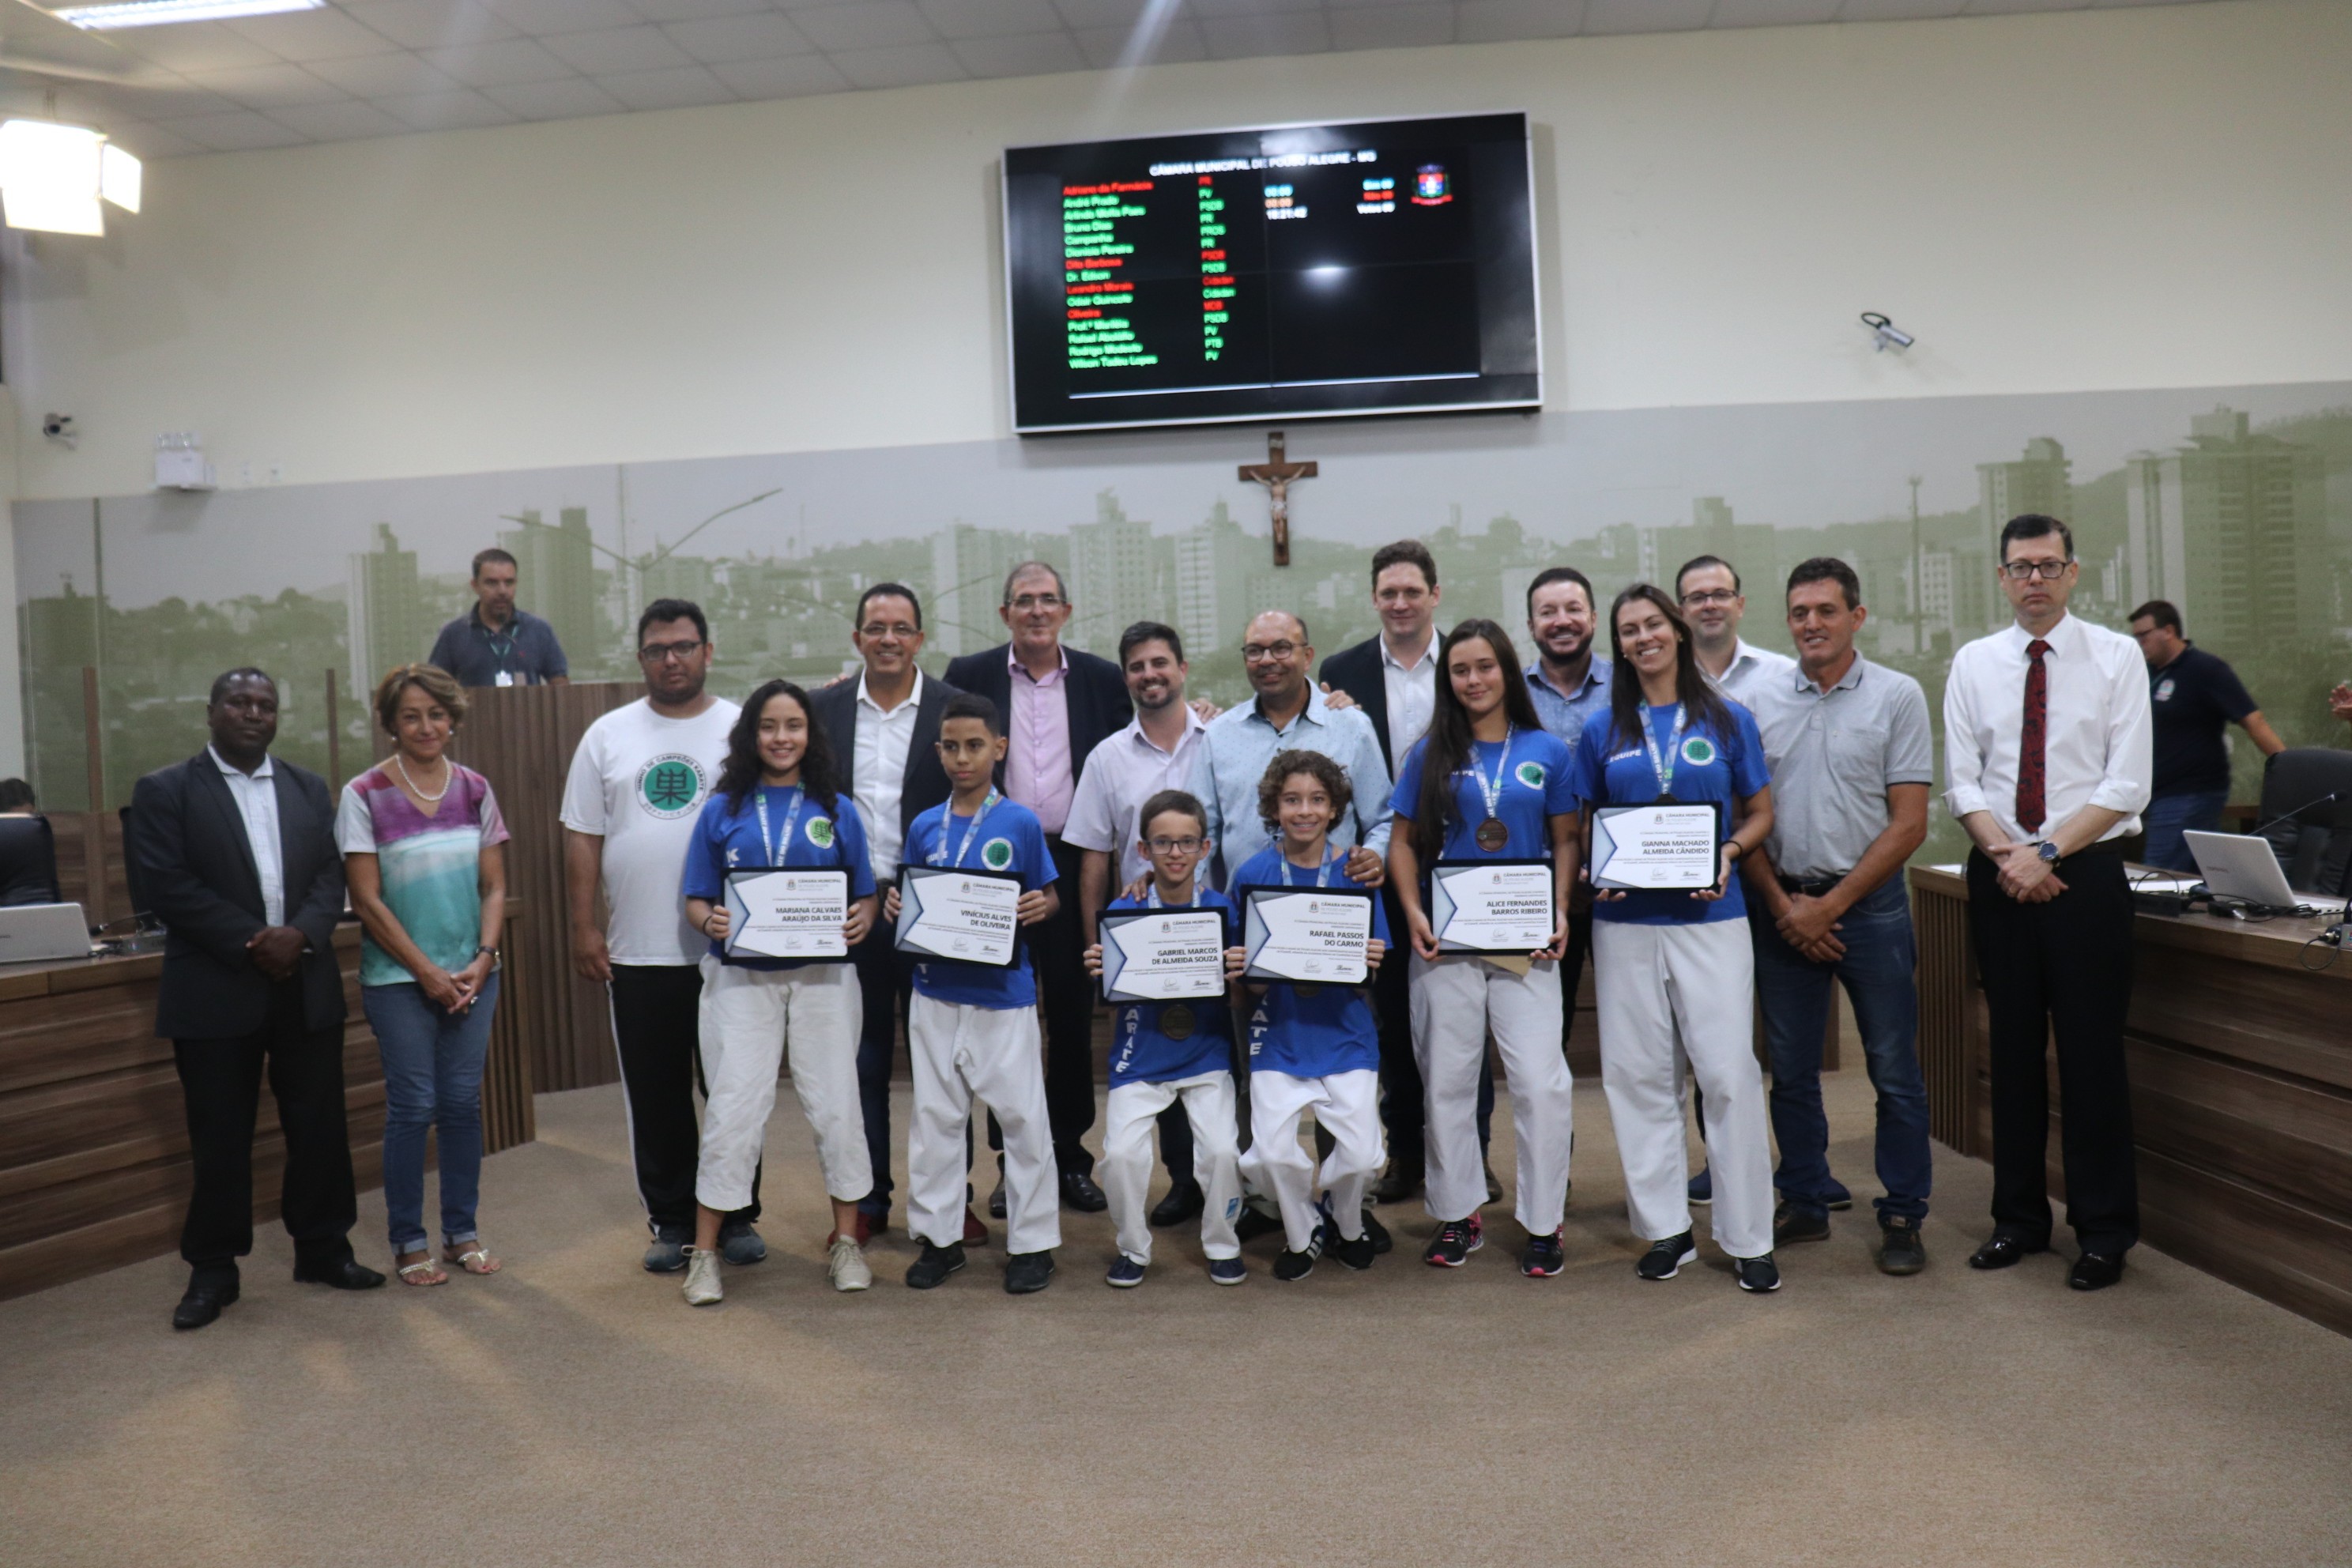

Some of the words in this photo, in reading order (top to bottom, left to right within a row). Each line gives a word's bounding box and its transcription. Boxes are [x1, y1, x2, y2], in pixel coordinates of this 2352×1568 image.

[1149, 163, 1194, 176] CÂMARA
[1195, 159, 1250, 173] MUNICIPAL
[1308, 152, 1351, 166] ALEGRE
[1199, 188, 1212, 198] PV
[1200, 212, 1215, 223] PR
[1064, 223, 1091, 232] Bruno
[1092, 220, 1114, 231] Dias
[1065, 233, 1114, 245] Campanha
[1200, 237, 1216, 248] PR
[1204, 325, 1219, 336] PV
[1205, 350, 1219, 360] PV
[782, 914, 809, 923] ARAÚJO
[960, 909, 989, 919] VINÍCIUS
[981, 921, 1011, 930] OLIVEIRA
[1115, 1004, 1140, 1072] ARATE
